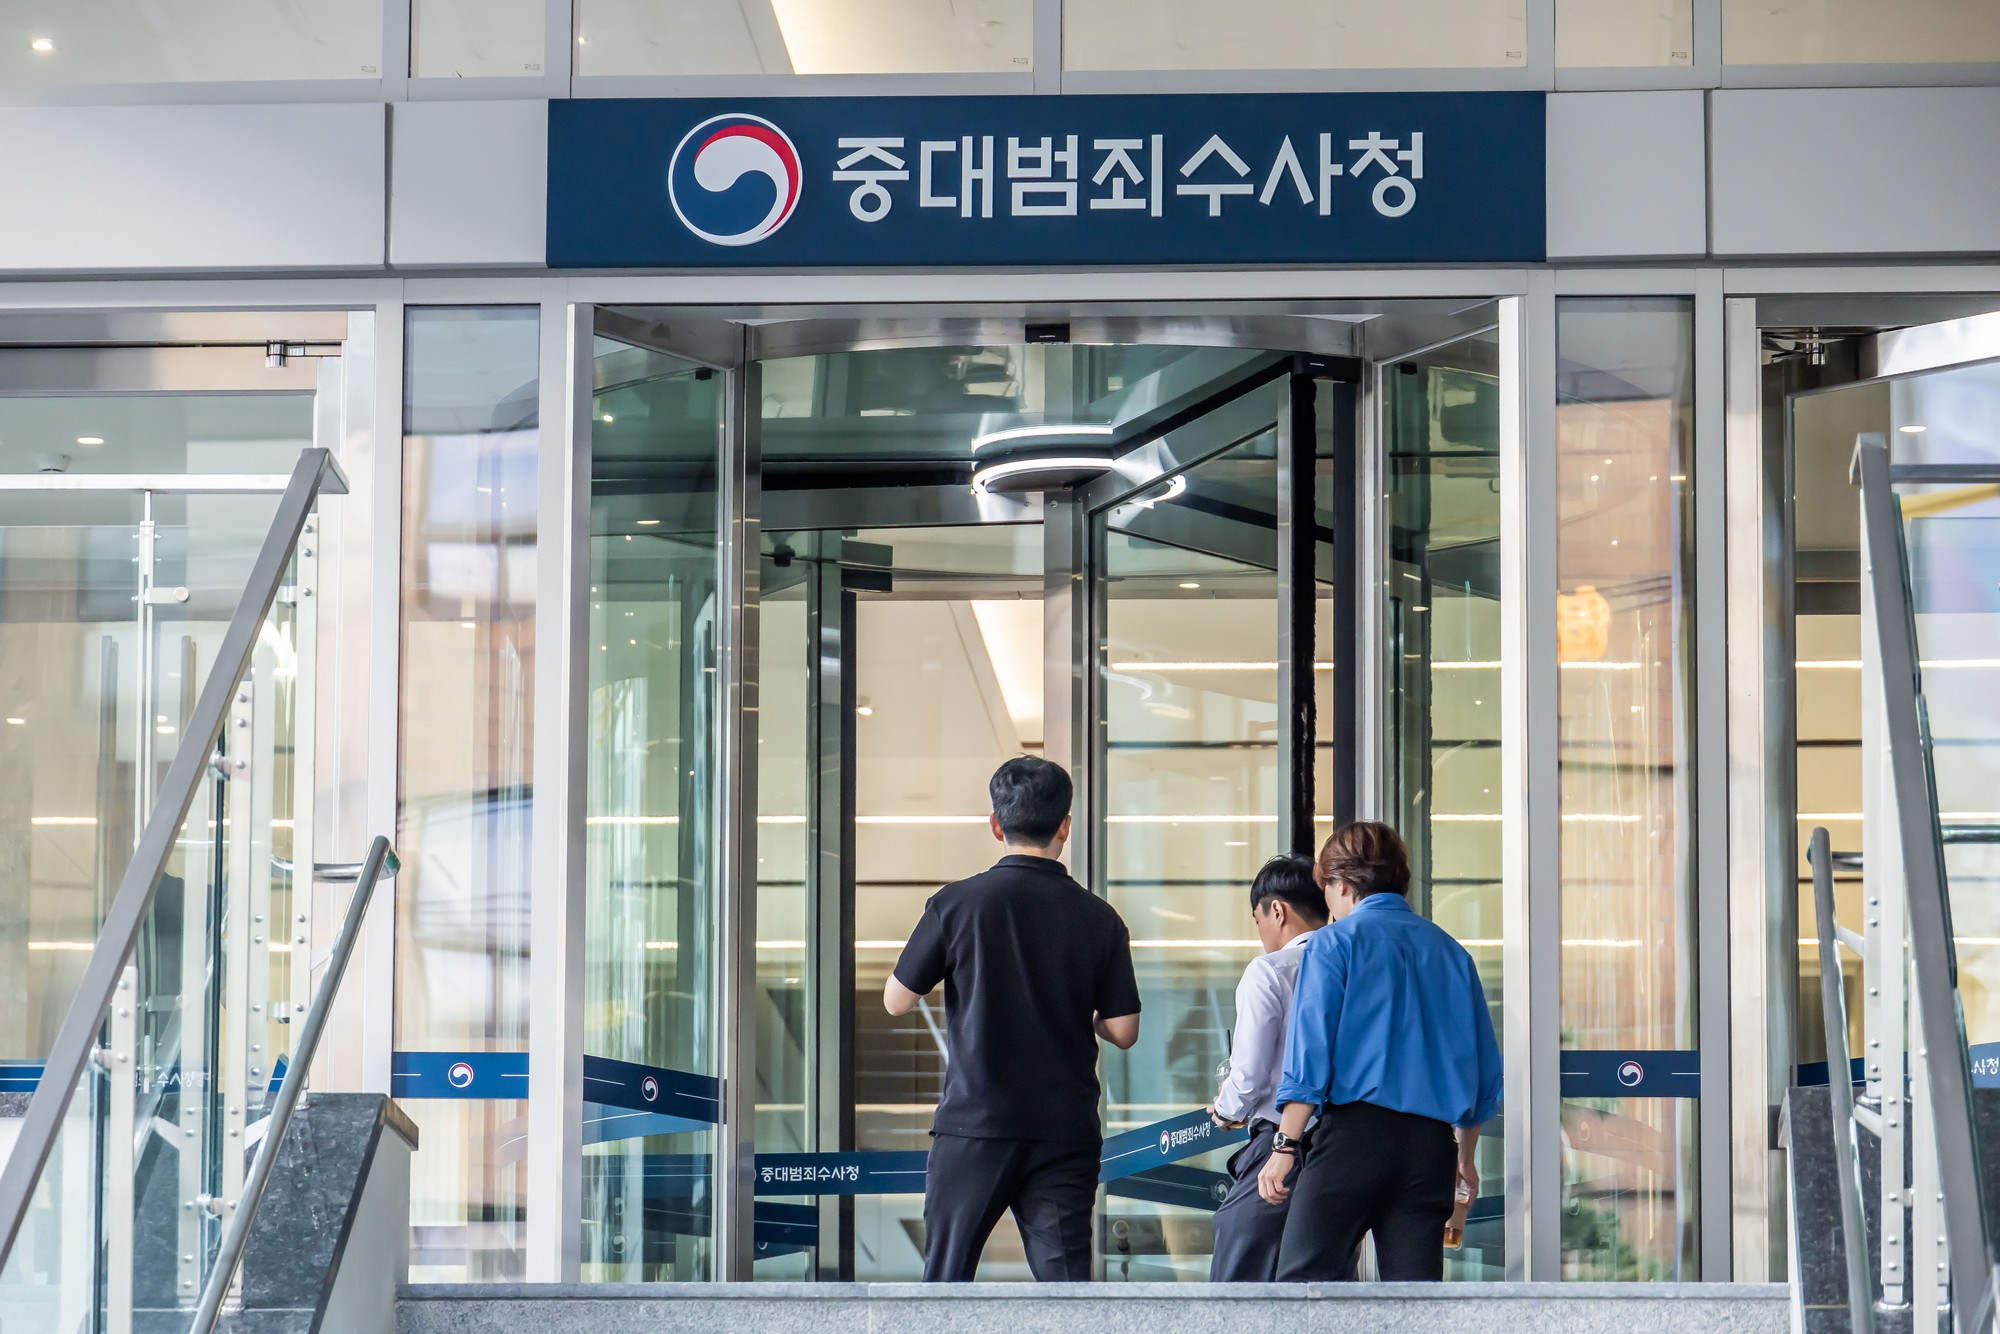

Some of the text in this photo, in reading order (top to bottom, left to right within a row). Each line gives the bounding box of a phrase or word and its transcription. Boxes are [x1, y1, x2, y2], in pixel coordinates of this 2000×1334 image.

[832, 131, 1424, 223] 중대범죄수사청
[1170, 1120, 1211, 1148] 중대범죄수사청
[760, 1165, 860, 1183] 중대범죄수사청
